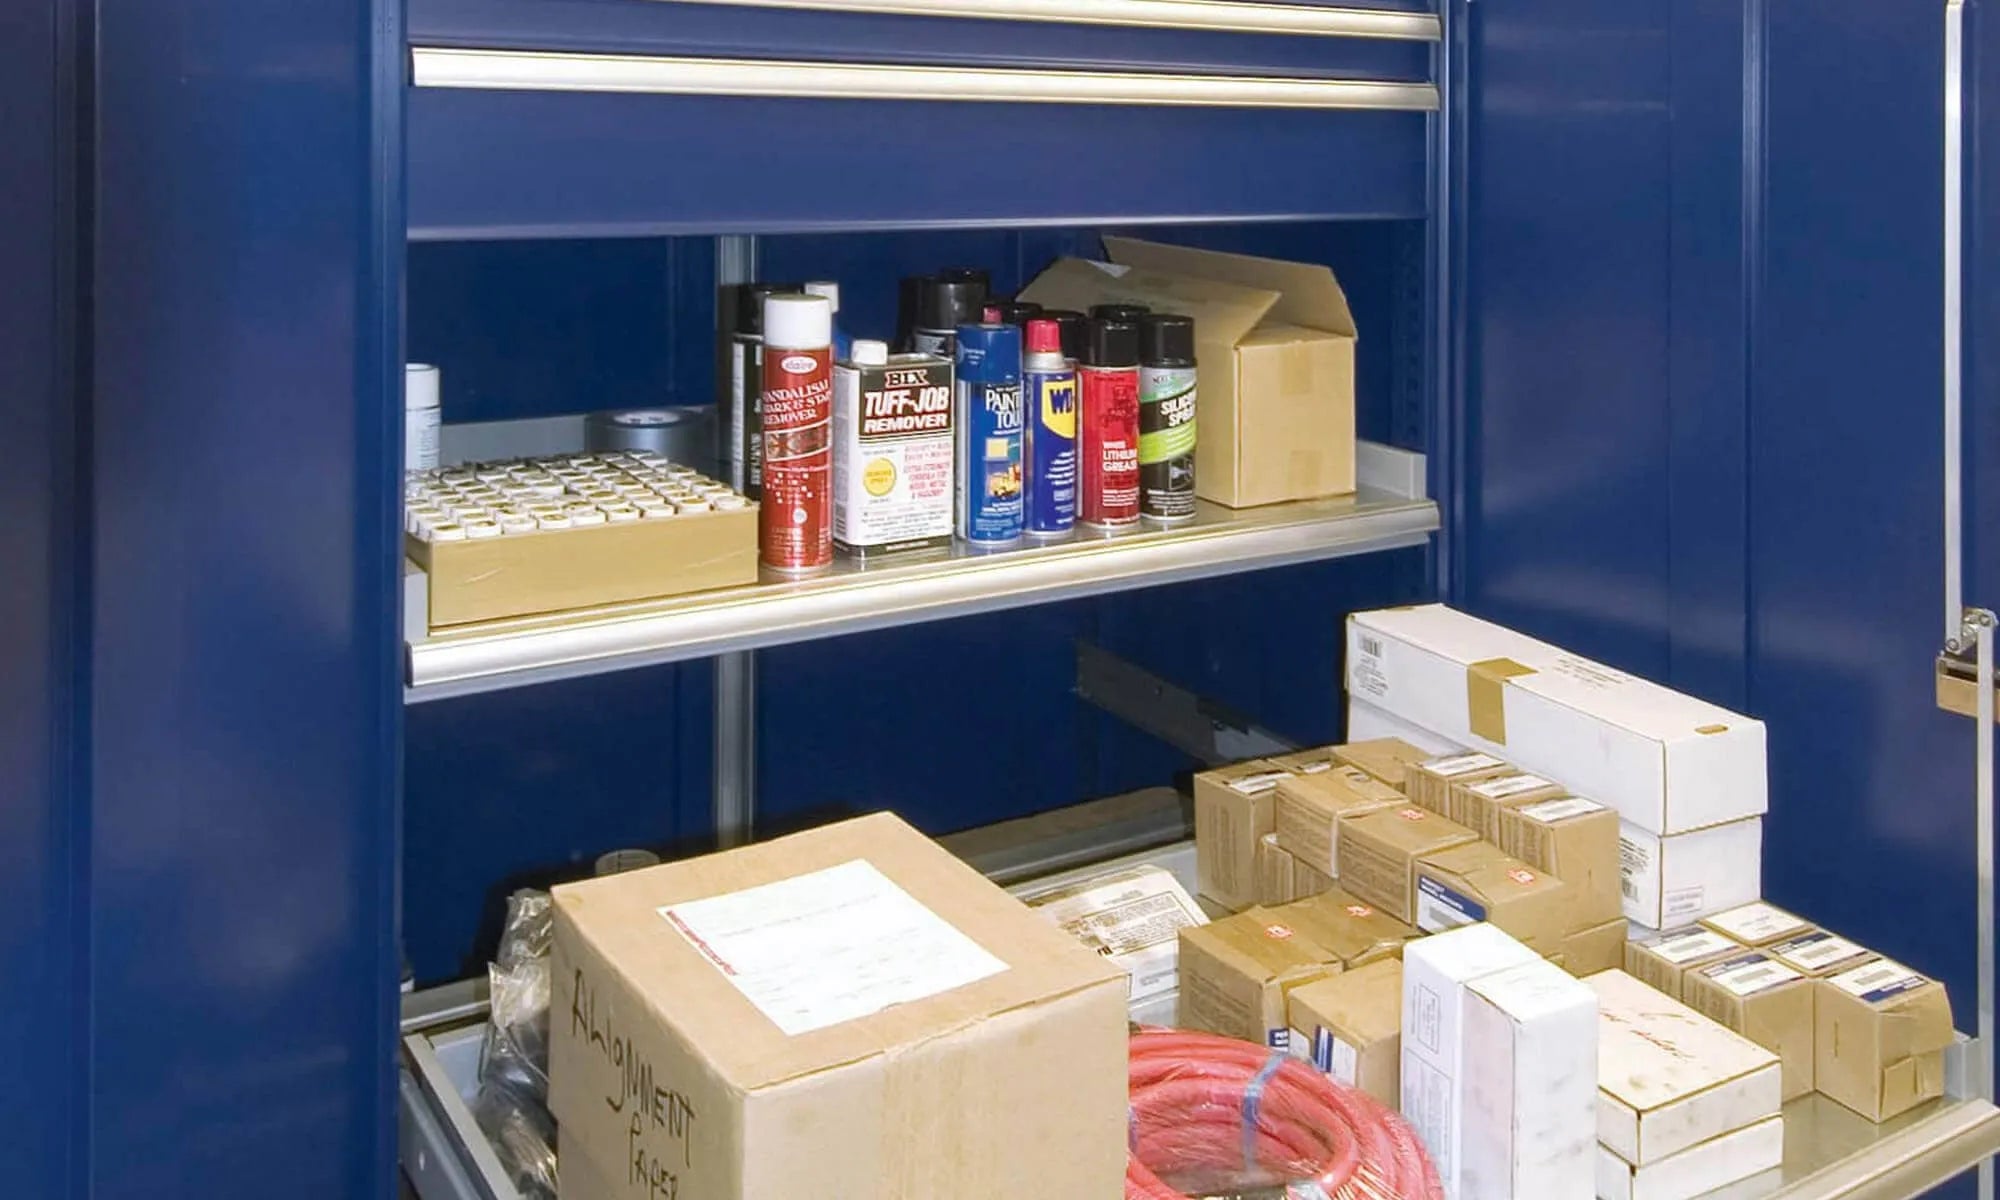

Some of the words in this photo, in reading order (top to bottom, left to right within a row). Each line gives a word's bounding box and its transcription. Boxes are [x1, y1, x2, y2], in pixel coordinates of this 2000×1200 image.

[887, 371, 927, 387] BIX
[864, 387, 950, 417] TUFF-JOB
[863, 413, 948, 433] REMOVER
